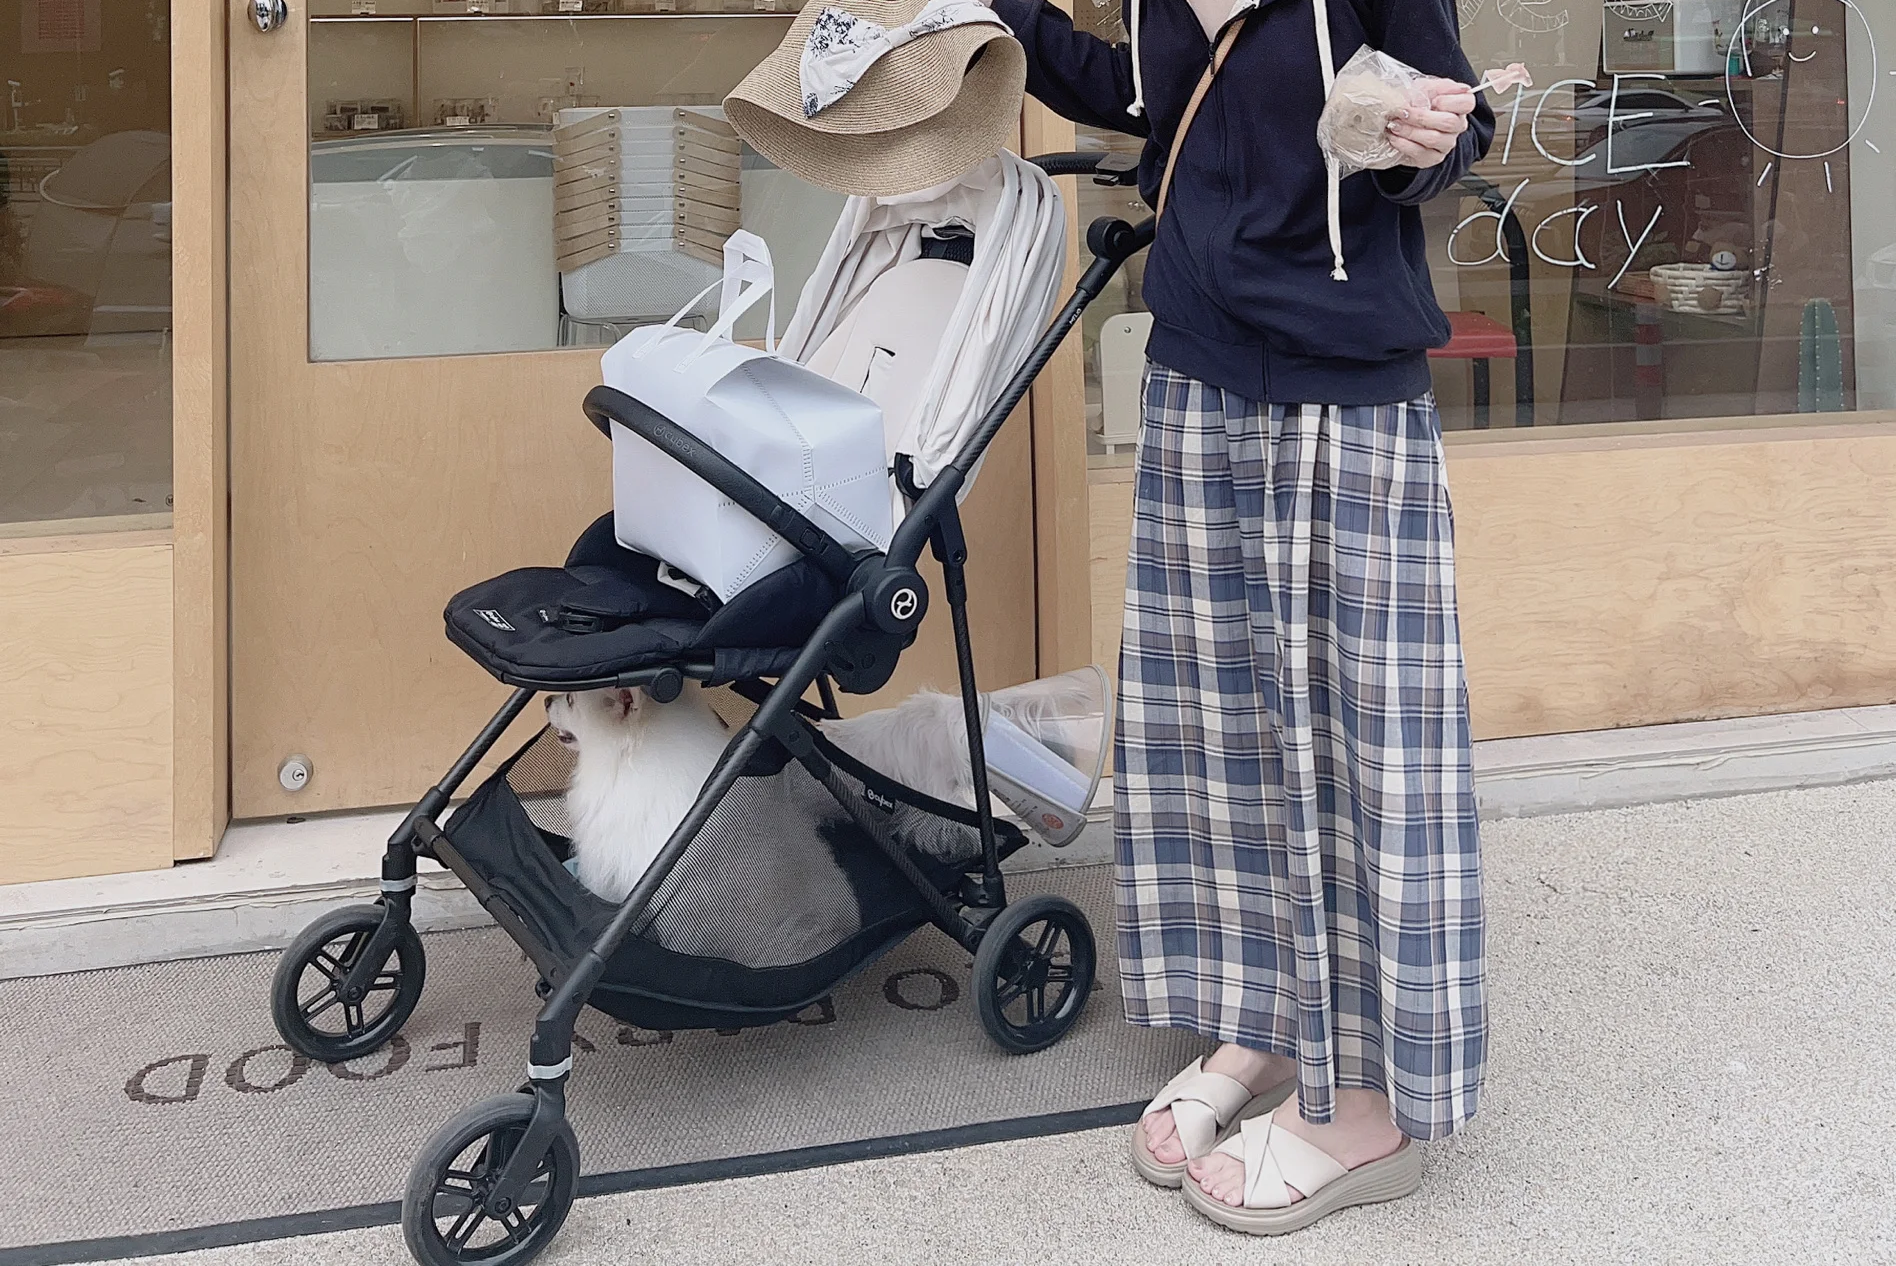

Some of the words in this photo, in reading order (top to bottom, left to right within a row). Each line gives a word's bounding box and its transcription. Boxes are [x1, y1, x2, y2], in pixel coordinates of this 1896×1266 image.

[1501, 72, 1691, 175] ICE
[1447, 177, 1664, 290] day
[664, 432, 696, 457] cybex
[123, 1020, 483, 1106] FOOD
